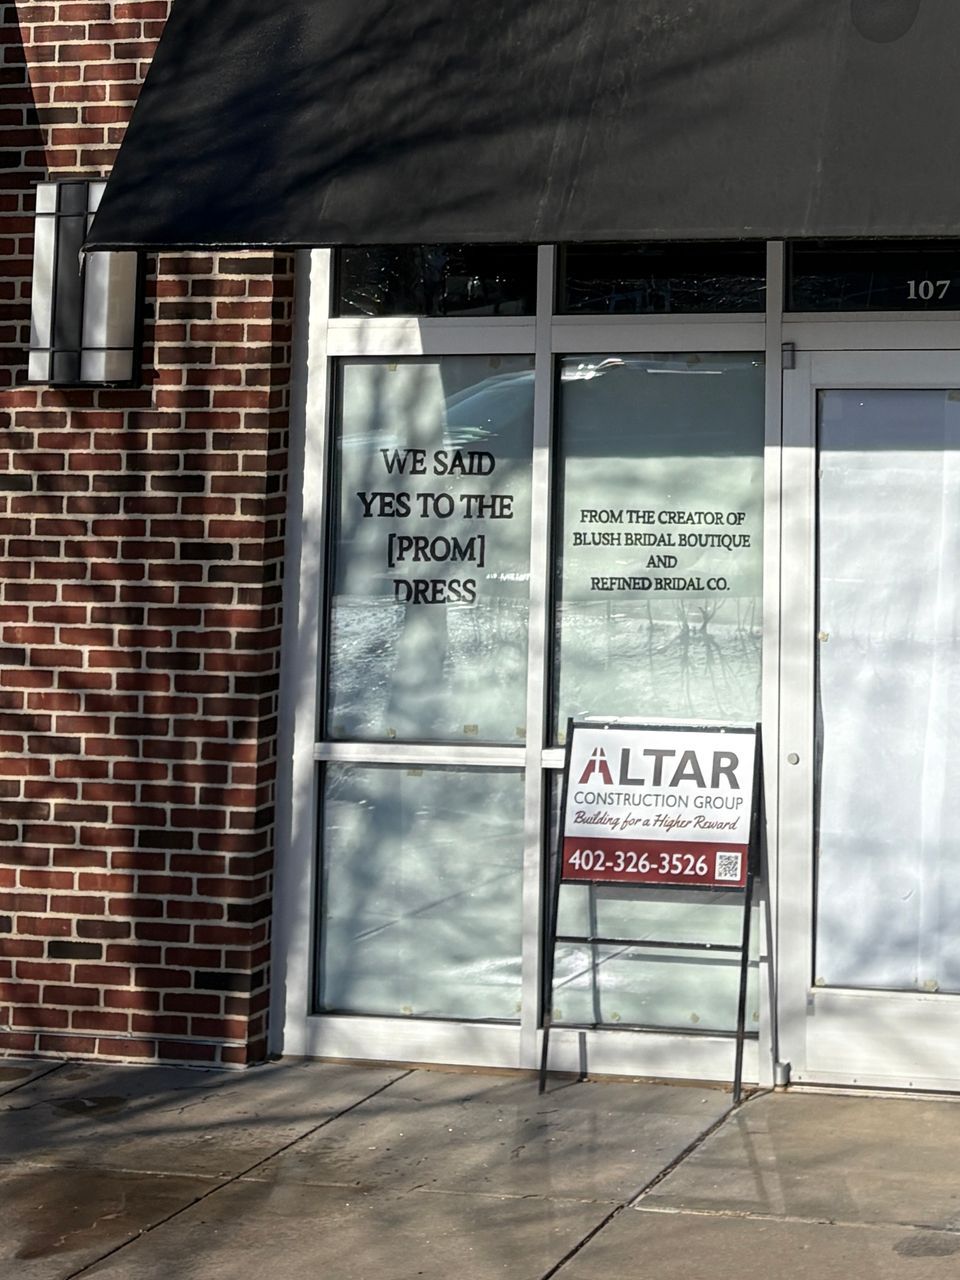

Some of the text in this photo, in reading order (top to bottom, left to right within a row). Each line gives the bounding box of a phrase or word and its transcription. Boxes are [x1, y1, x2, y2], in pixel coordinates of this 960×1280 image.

[907, 279, 951, 300] 107
[380, 448, 496, 476] WE SAID
[357, 492, 514, 519] YES TO THE
[580, 509, 746, 525] FROM THE CREATOR OF
[388, 533, 486, 568] [PROM]
[572, 532, 751, 551] BLUSH BRIDAL BOUTIQUE
[646, 554, 678, 568] AND
[393, 578, 477, 605] DRESS
[590, 577, 731, 591] REFINED BRIDAL CO.
[578, 746, 741, 790] ALTAR
[574, 791, 744, 810] CONSTRUCTION GROUP
[573, 810, 741, 833] Building for a Higher Reward
[568, 849, 708, 876] 402-326-3526
